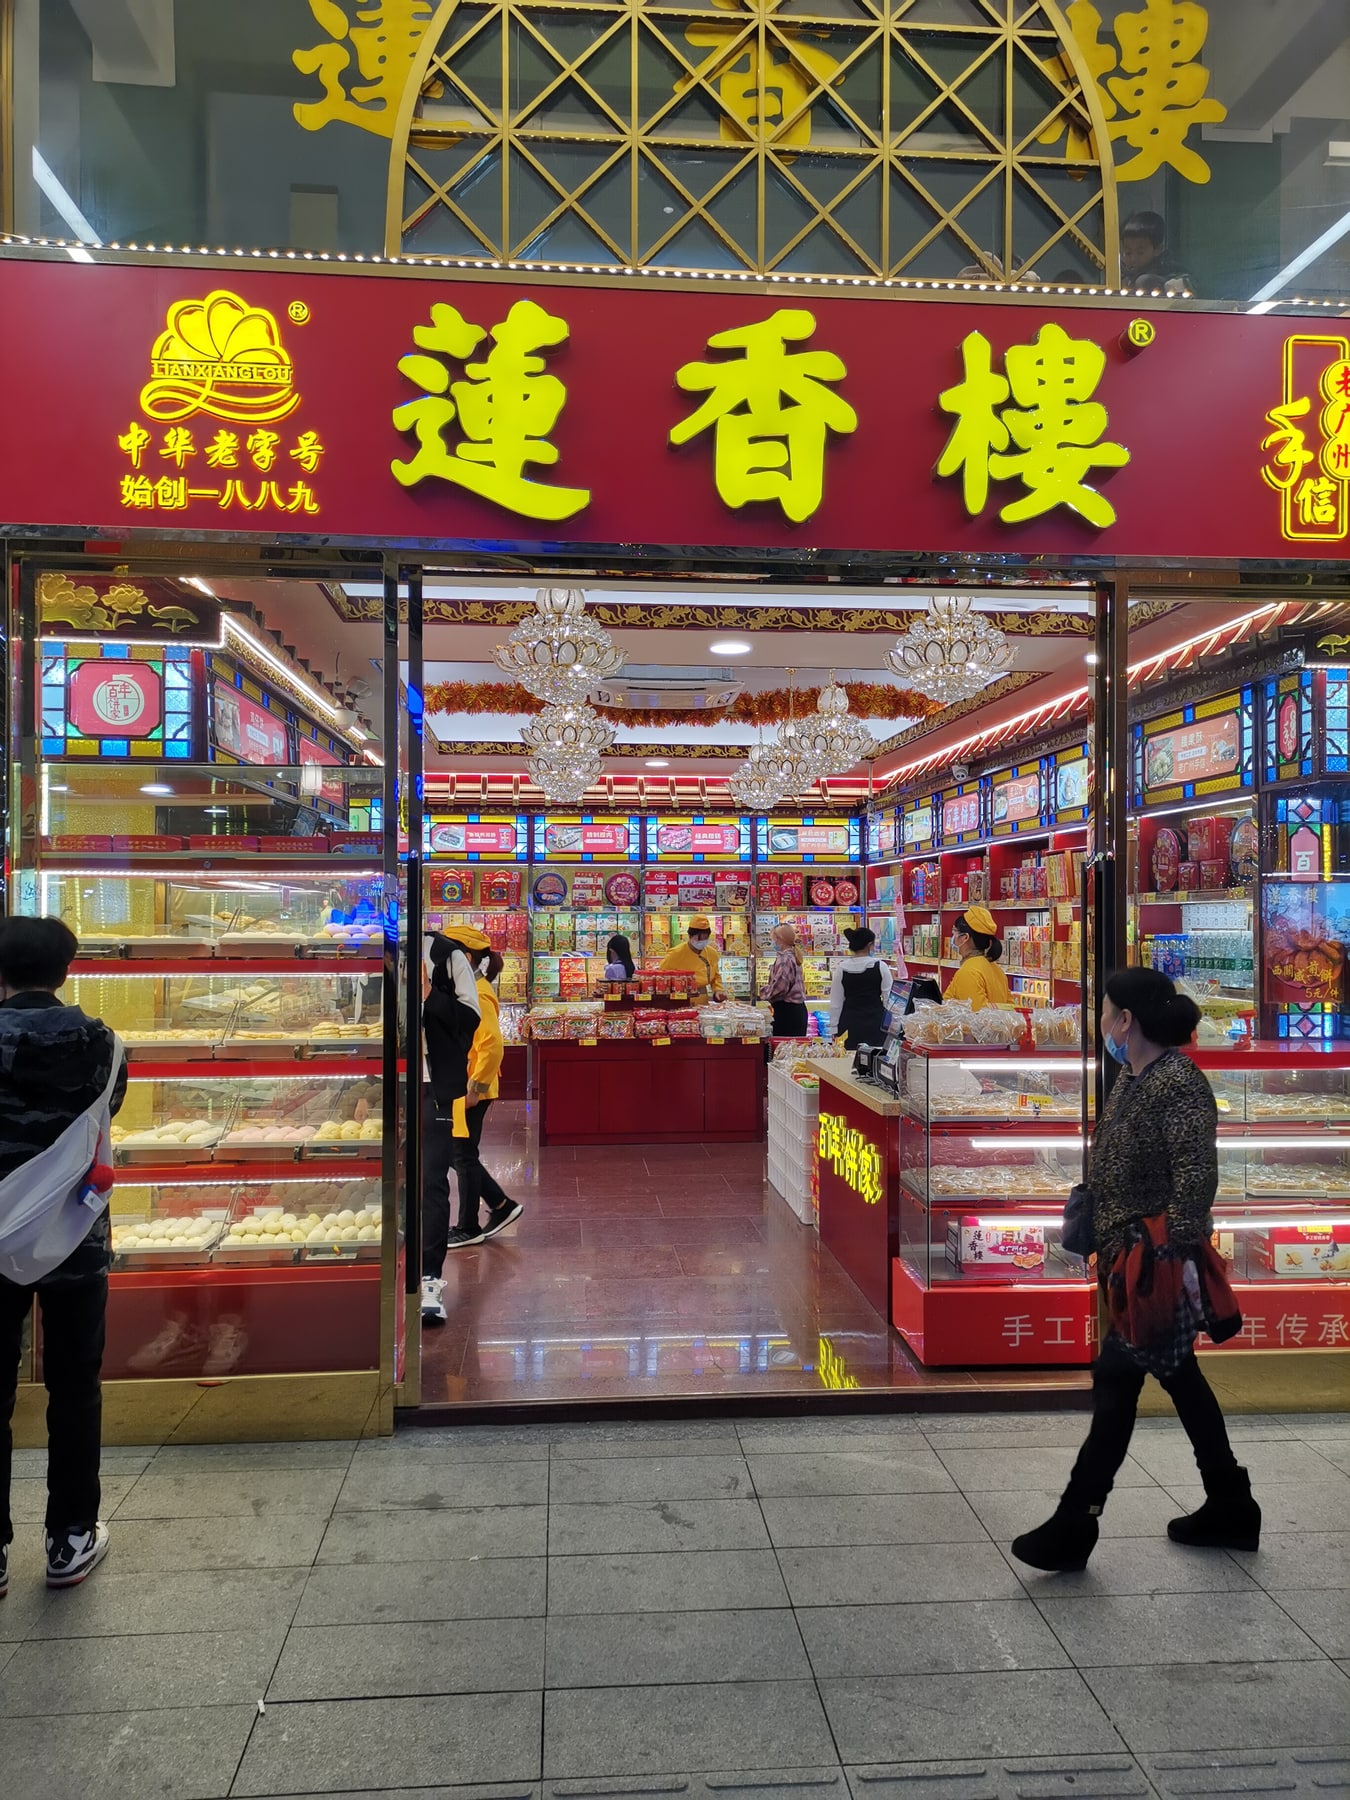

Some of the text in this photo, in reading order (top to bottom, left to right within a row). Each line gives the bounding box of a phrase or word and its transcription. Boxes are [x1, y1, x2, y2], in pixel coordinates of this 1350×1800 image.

[152, 362, 291, 381] LIANXIANGLOU
[118, 422, 324, 472] 中华老字号
[120, 475, 320, 513] 始创一八八九
[1199, 1313, 1350, 1346] 年传承
